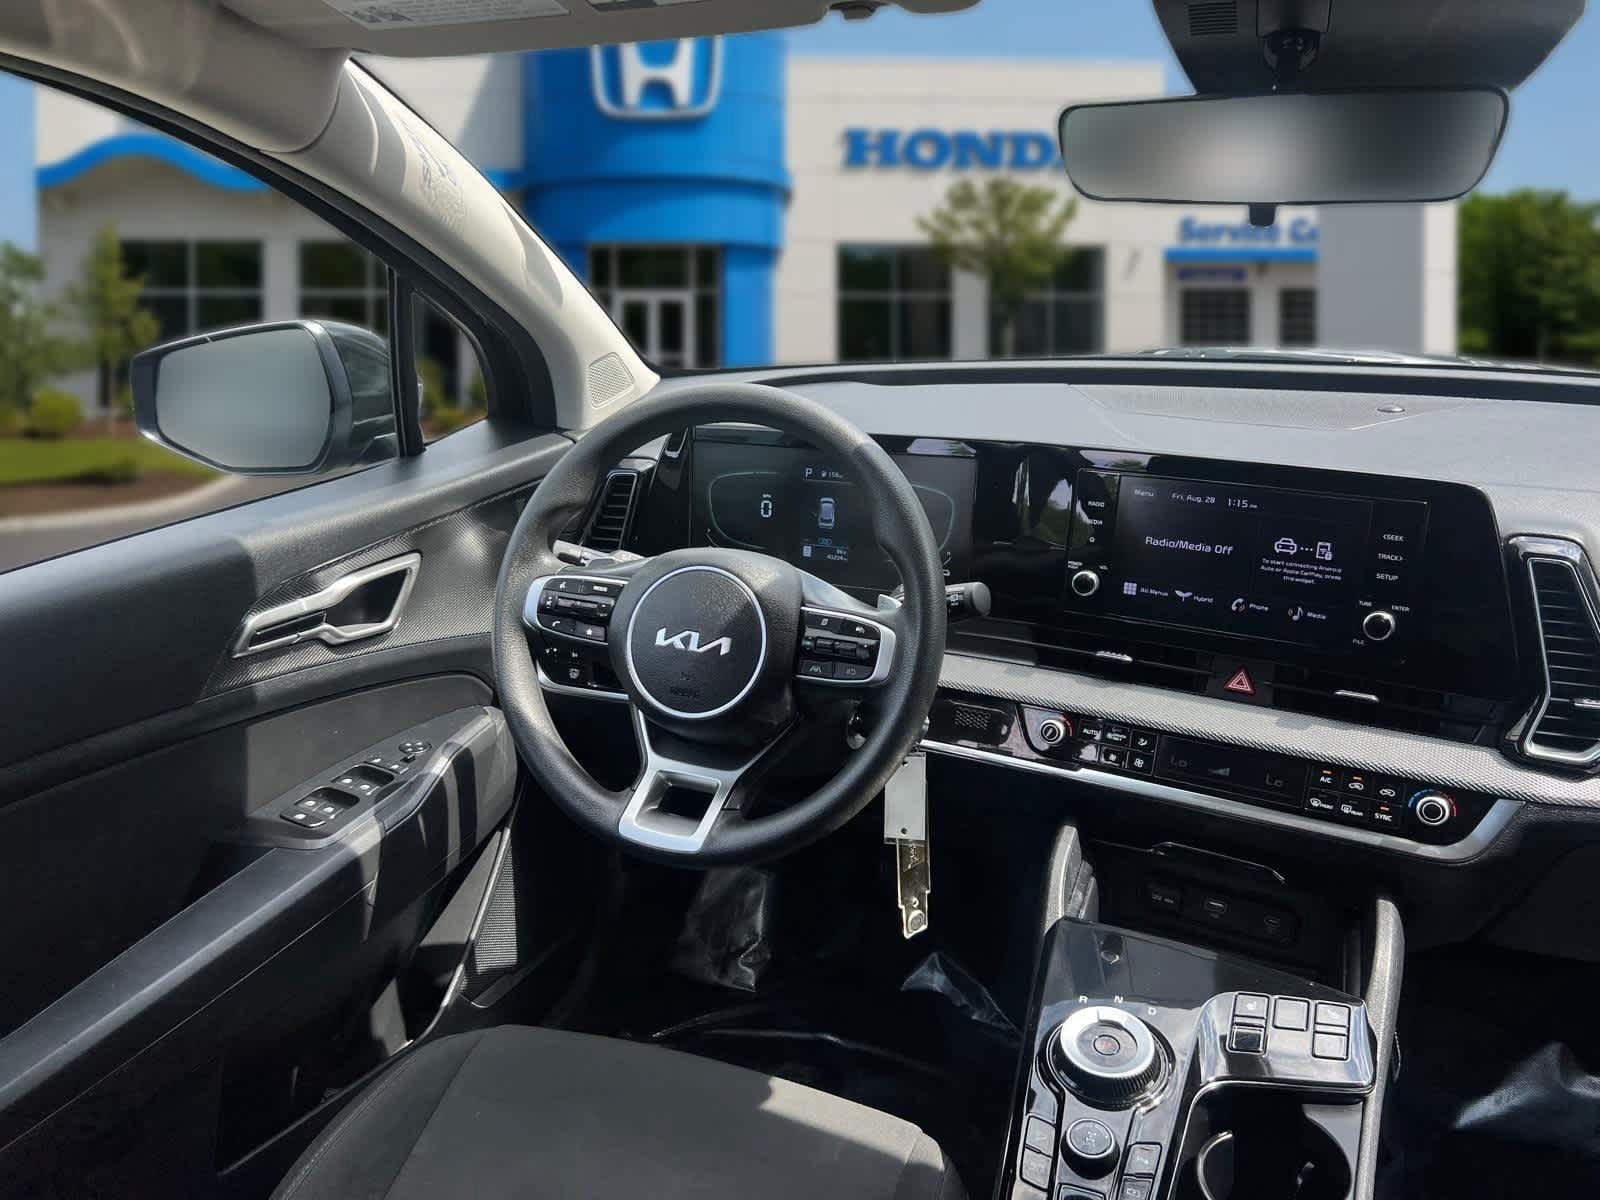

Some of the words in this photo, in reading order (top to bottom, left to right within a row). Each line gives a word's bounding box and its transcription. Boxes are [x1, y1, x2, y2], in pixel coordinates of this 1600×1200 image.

[844, 126, 1064, 171] HOND
[804, 468, 813, 478] P
[1134, 488, 1155, 497] Menu
[1204, 496, 1216, 504] 28
[1227, 498, 1248, 508] 1:15
[760, 500, 773, 518] 0
[1145, 536, 1211, 553] Radio/Media
[1214, 544, 1233, 555] Off
[1376, 573, 1398, 581] SETUP
[1249, 603, 1269, 611] Phone
[1306, 611, 1327, 620] Media
[1320, 776, 1333, 784] A/C
[1374, 812, 1393, 822] SYNC
[1079, 995, 1088, 1003] R
[1114, 995, 1123, 1003] N
[1148, 1008, 1157, 1016] D
